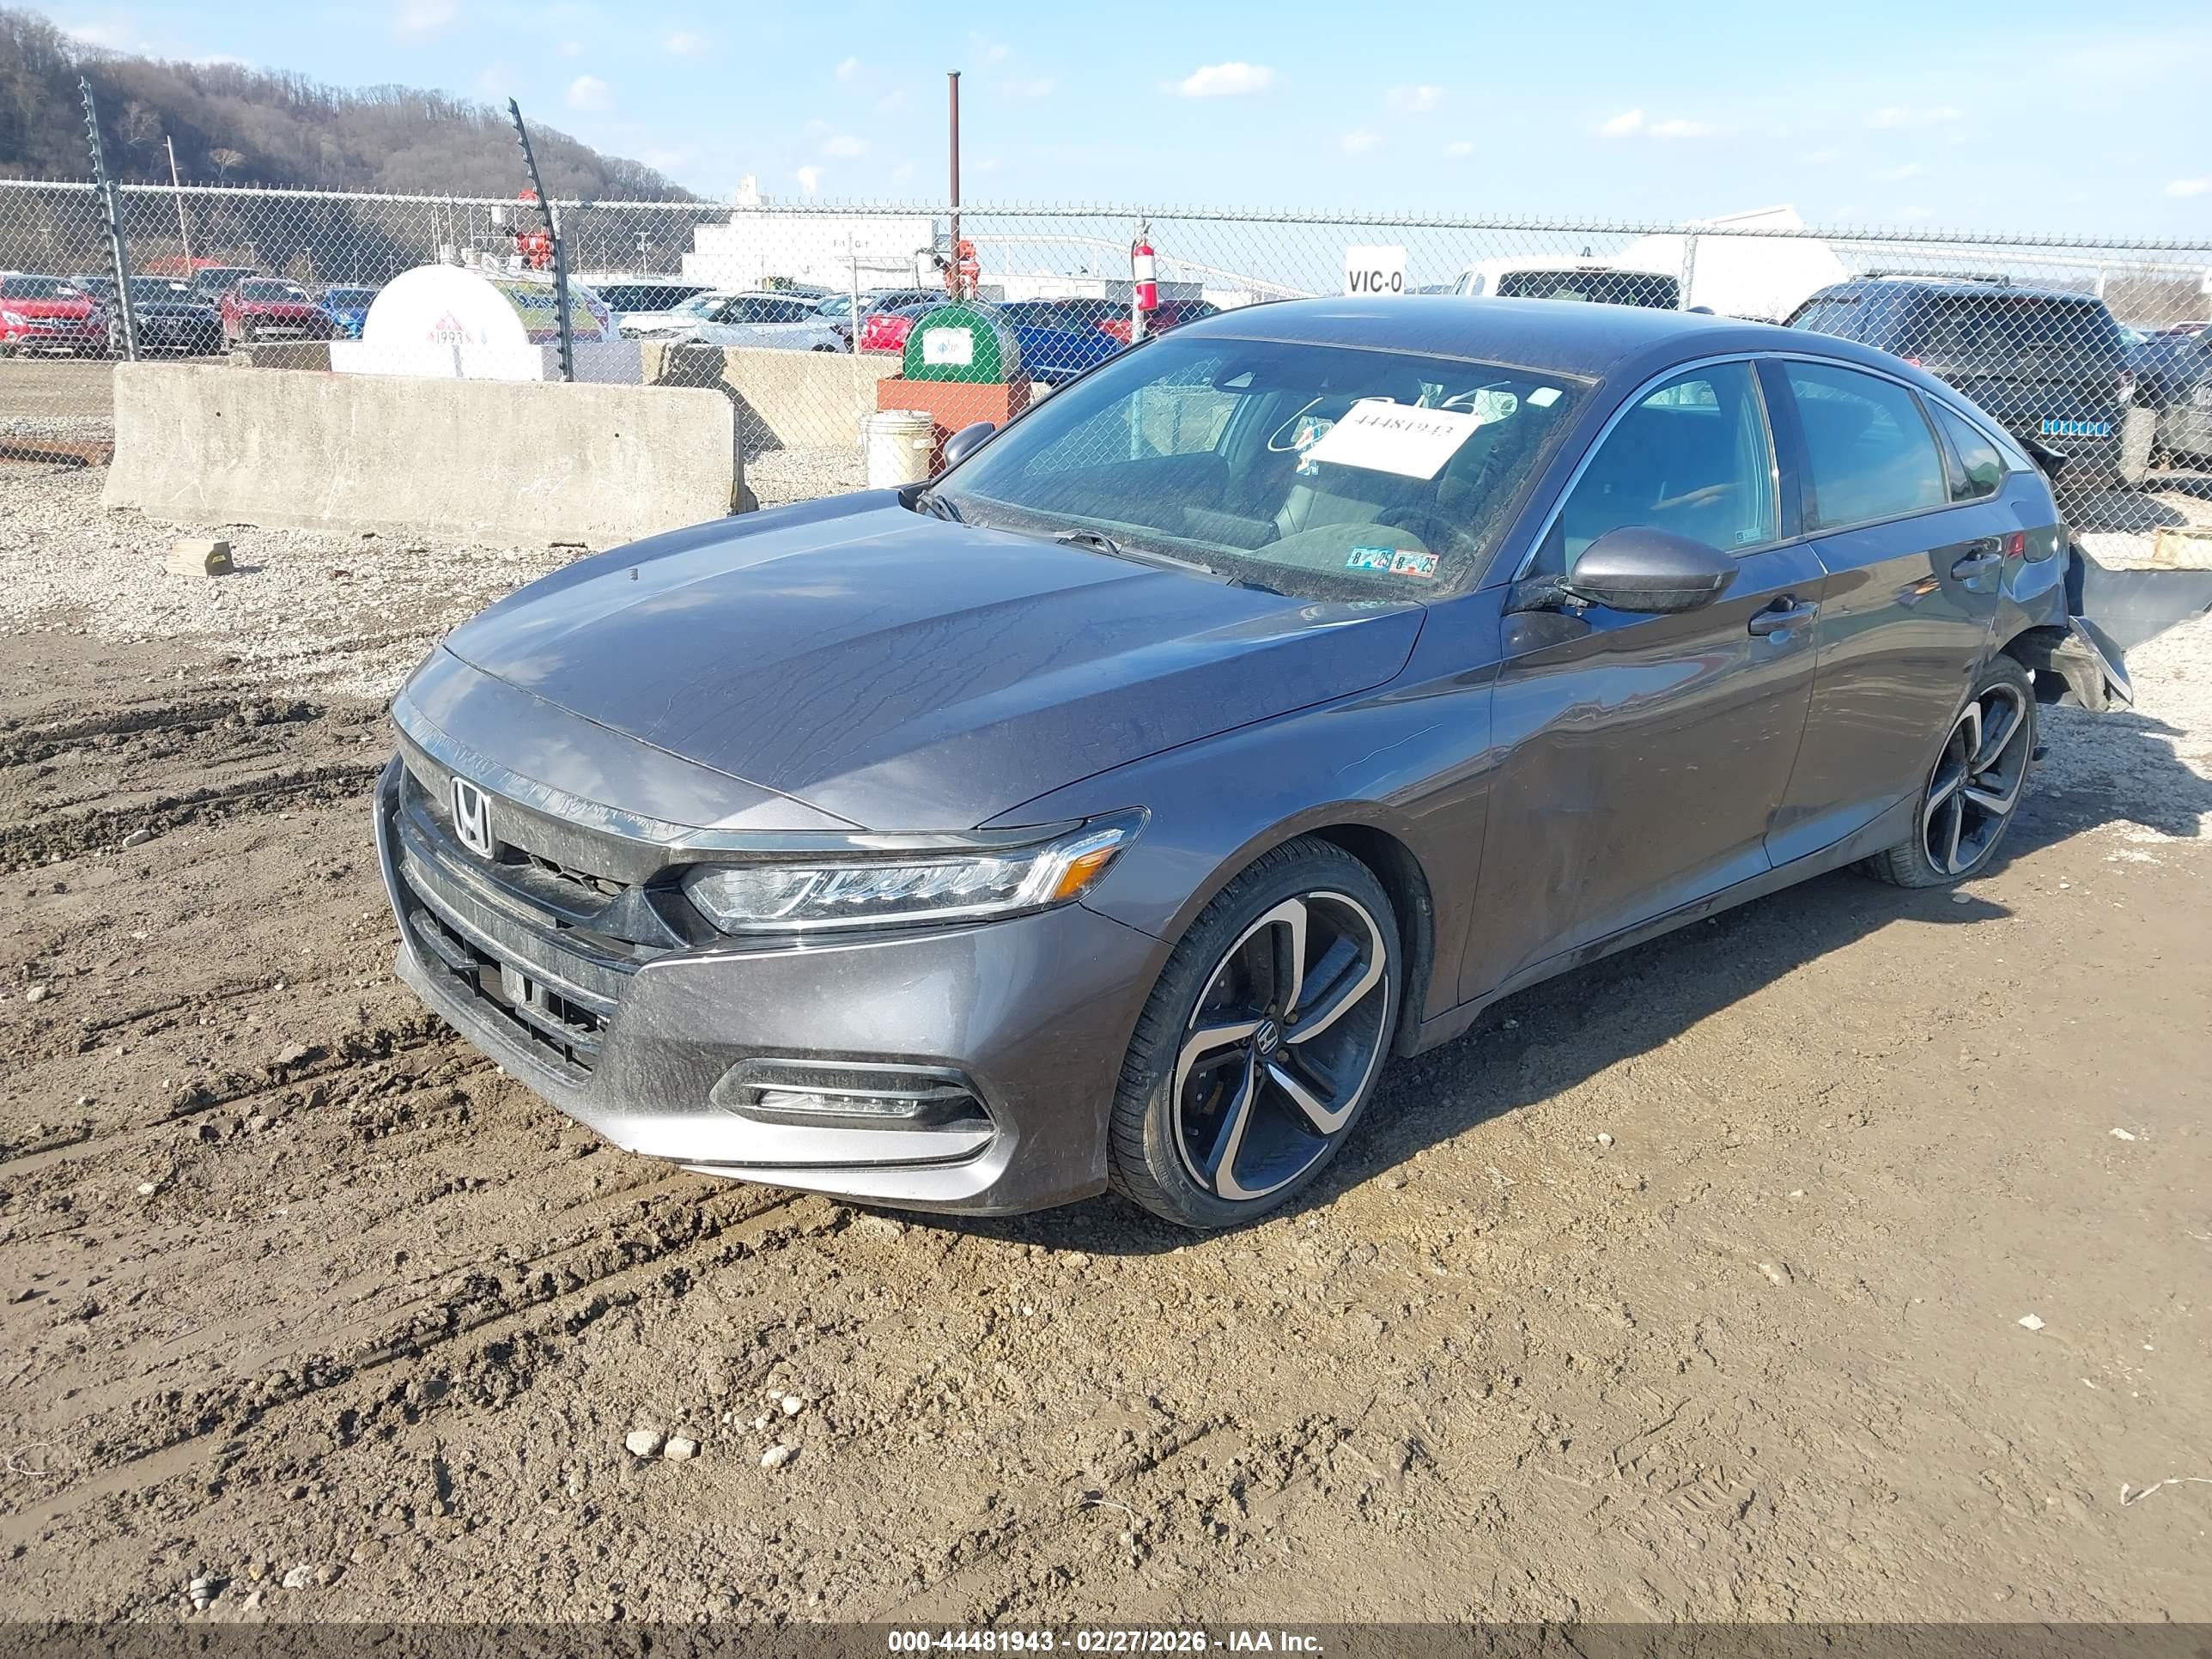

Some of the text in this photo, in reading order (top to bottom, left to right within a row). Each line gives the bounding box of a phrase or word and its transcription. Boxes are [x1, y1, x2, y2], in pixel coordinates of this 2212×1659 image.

[436, 331, 463, 344] 1993
[1352, 551, 1391, 567] 8 25
[1395, 556, 1436, 573] 8 25
